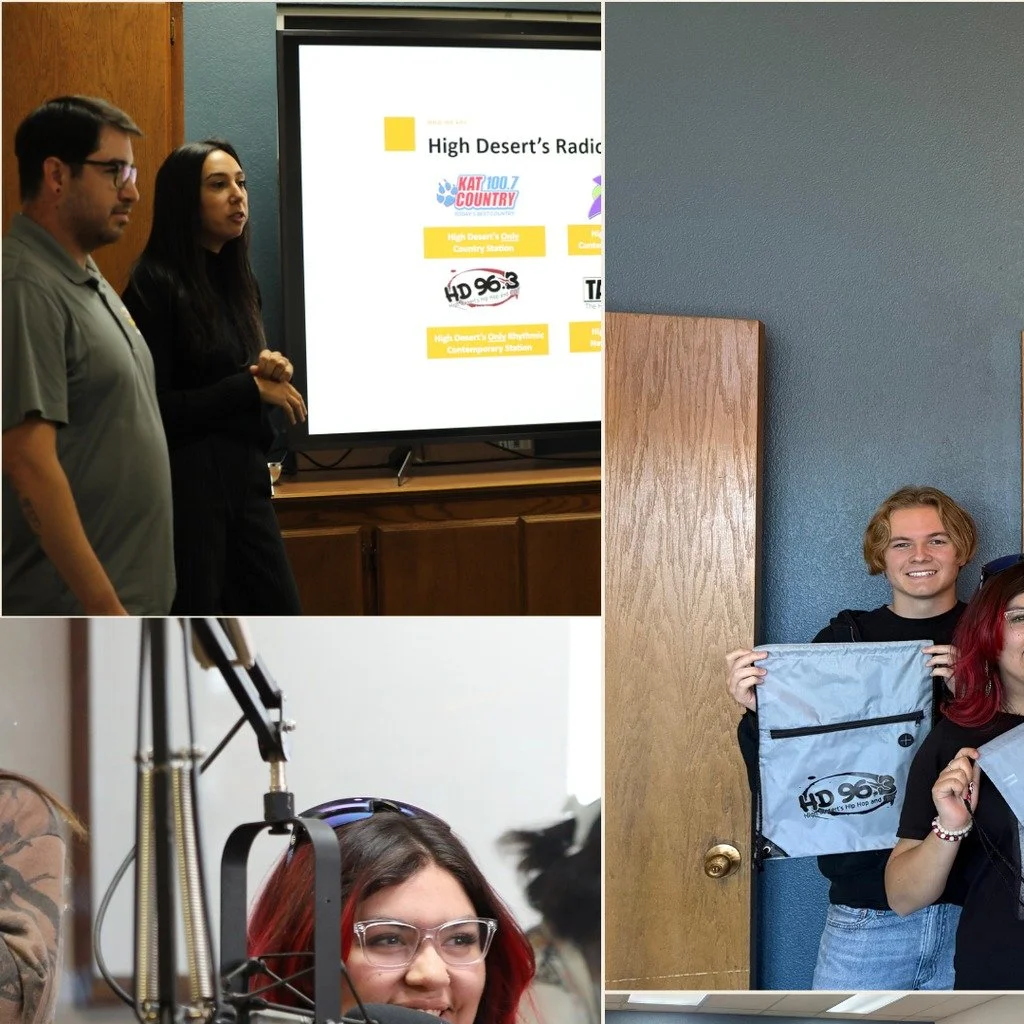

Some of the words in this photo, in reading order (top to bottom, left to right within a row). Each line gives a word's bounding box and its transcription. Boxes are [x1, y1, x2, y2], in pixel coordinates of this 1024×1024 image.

[428, 137, 470, 157] High
[457, 176, 483, 191] KAT
[487, 175, 520, 190] 100.7
[456, 191, 516, 207] COUNTRY
[447, 233, 468, 243] High
[453, 244, 485, 254] Country
[486, 243, 514, 252] Station
[444, 283, 472, 302] HD
[474, 271, 520, 296] 96.3
[504, 341, 532, 351] Station
[798, 789, 835, 813] HD
[837, 775, 897, 804] 96.3
